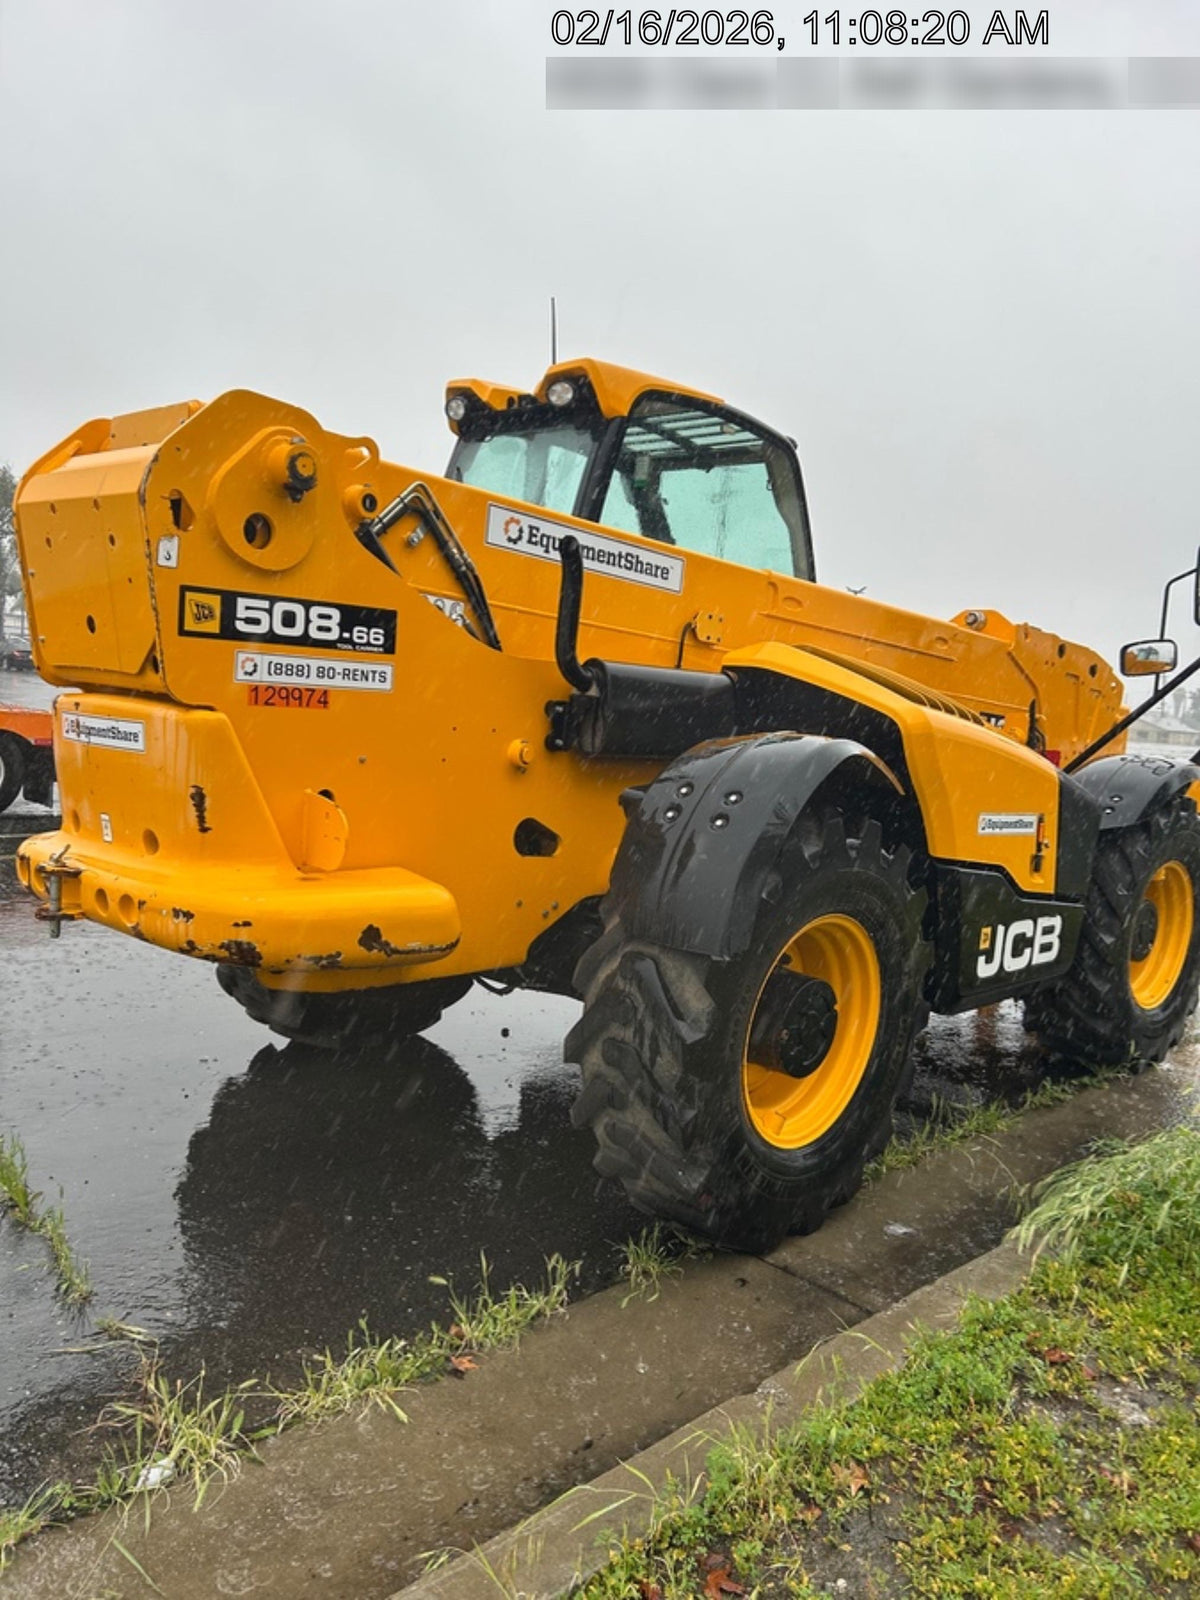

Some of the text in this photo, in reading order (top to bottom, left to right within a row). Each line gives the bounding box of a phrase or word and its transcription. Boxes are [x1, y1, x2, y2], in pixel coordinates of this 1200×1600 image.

[526, 524, 670, 581] EqumentShare
[267, 660, 388, 684] (888) 80-RENTS
[250, 685, 329, 708] 129974
[976, 915, 1063, 979] JCB
